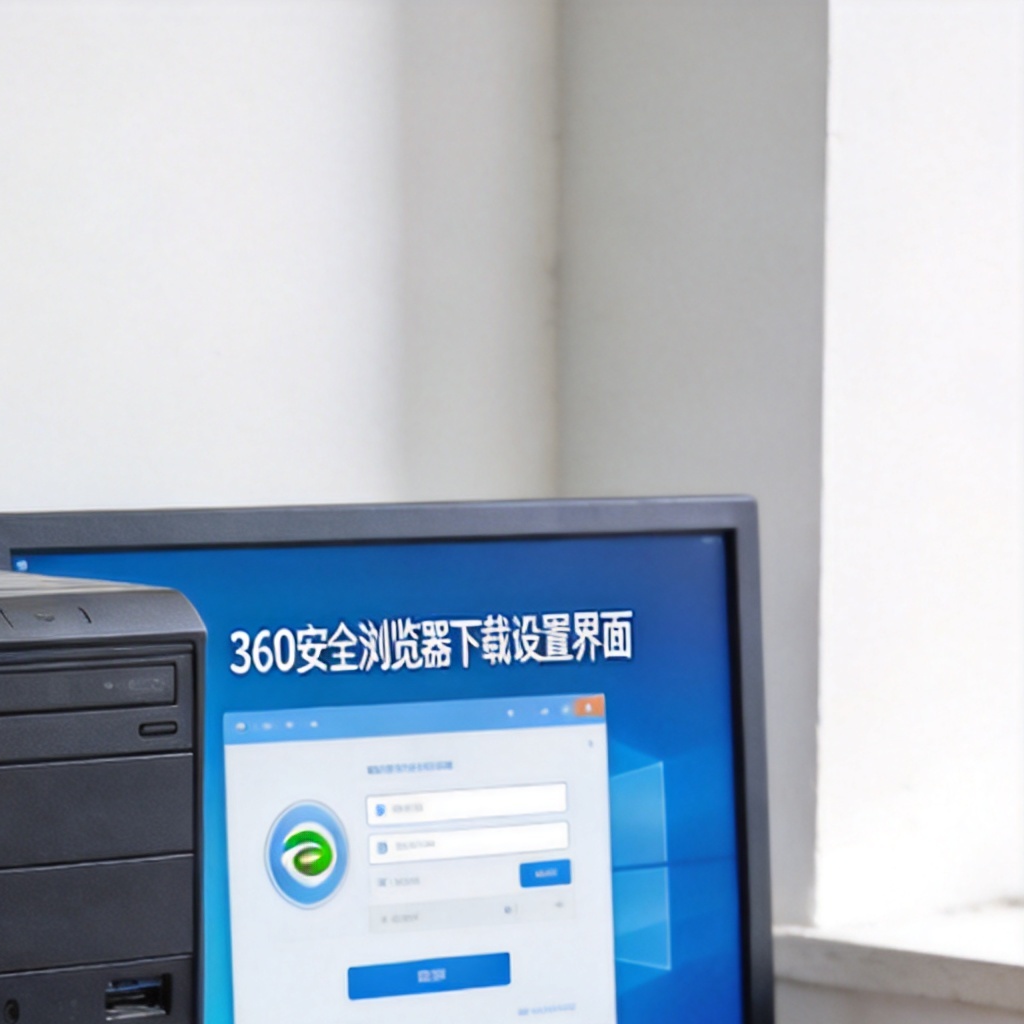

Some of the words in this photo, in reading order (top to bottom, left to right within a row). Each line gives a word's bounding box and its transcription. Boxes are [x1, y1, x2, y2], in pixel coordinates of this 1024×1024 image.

[230, 610, 633, 674] 360安全浏览器下载设置界面
